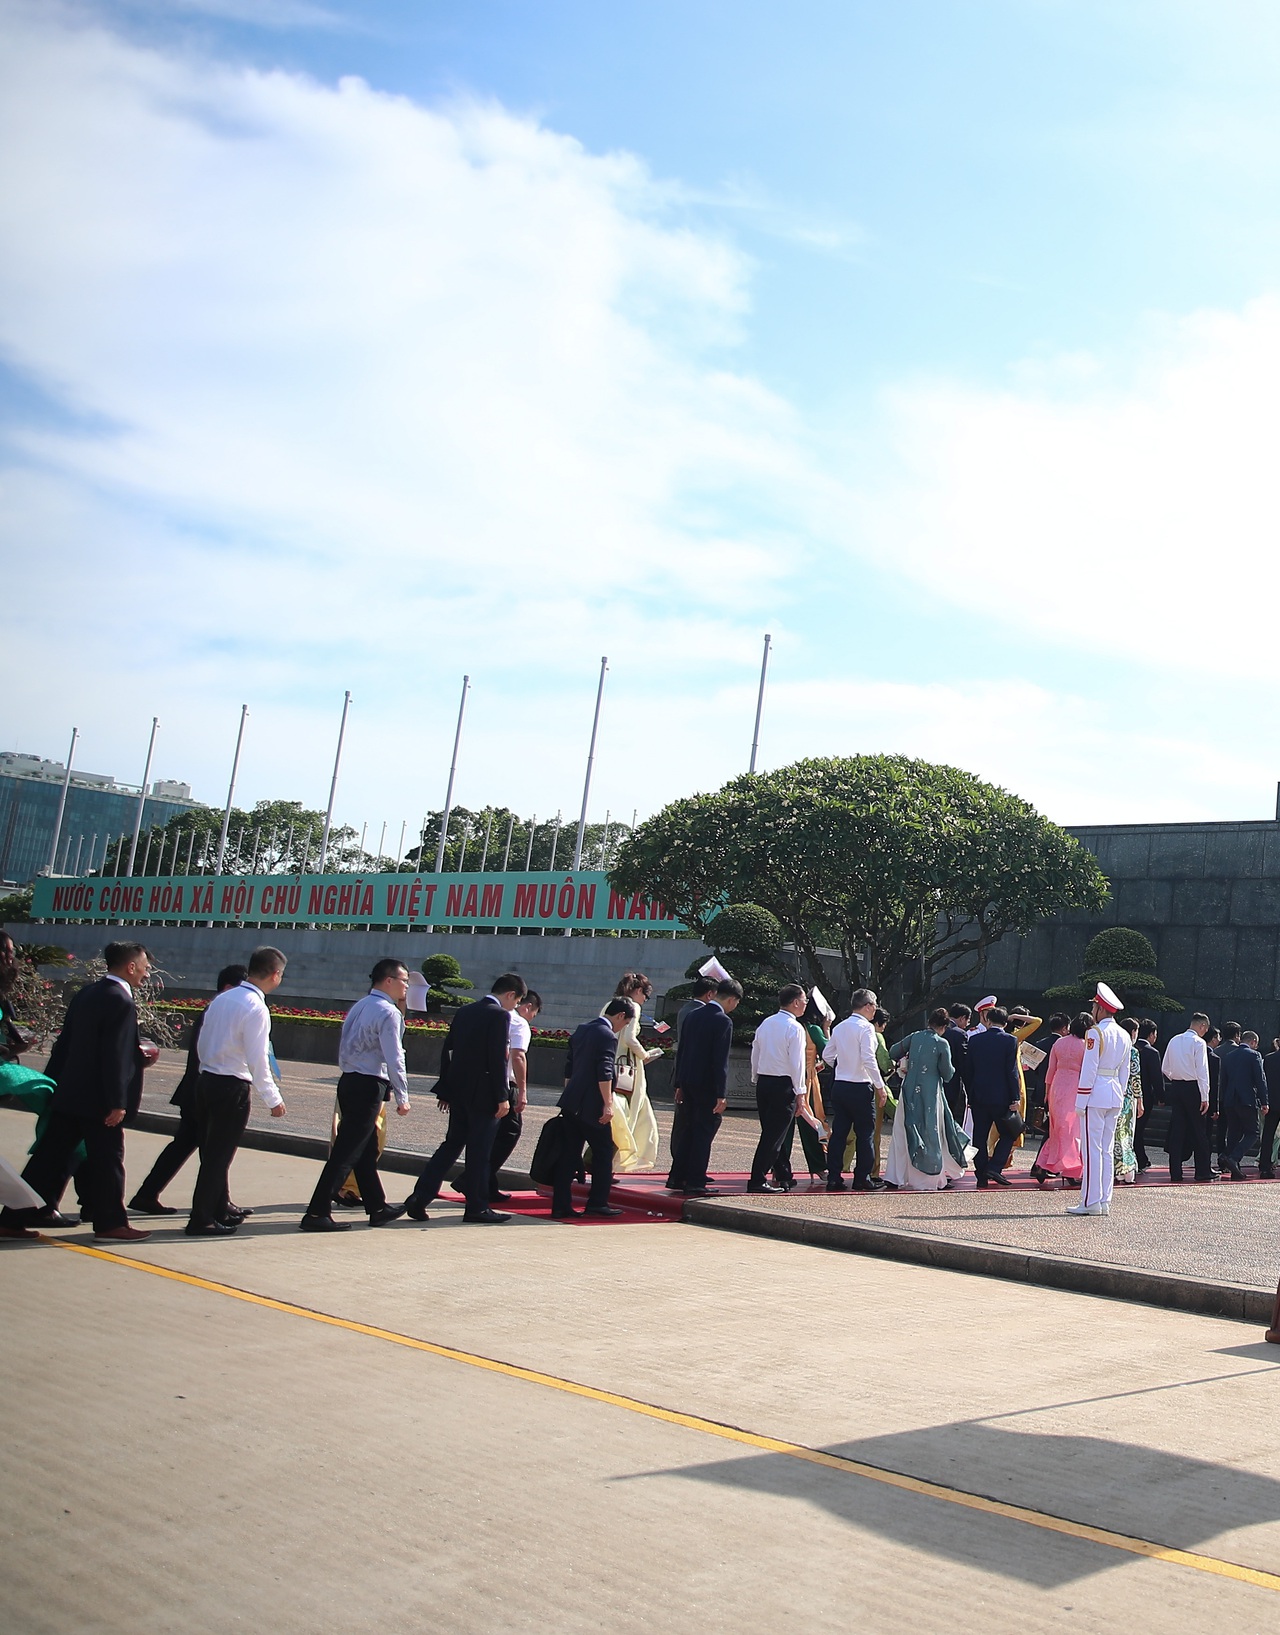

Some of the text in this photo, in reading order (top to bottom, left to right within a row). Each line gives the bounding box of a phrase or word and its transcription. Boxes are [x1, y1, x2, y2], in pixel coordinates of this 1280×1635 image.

[52, 883, 94, 912] NƯỚC
[99, 881, 144, 917] CỘNG
[148, 881, 183, 913] HÒA
[189, 880, 216, 914] XÃ
[220, 879, 254, 919] HỘI
[260, 876, 301, 915] CHỦ
[307, 878, 373, 916] NGHĨA
[386, 878, 437, 922] VIỆT
[445, 883, 504, 918] NAM
[513, 876, 597, 919] MUÔN
